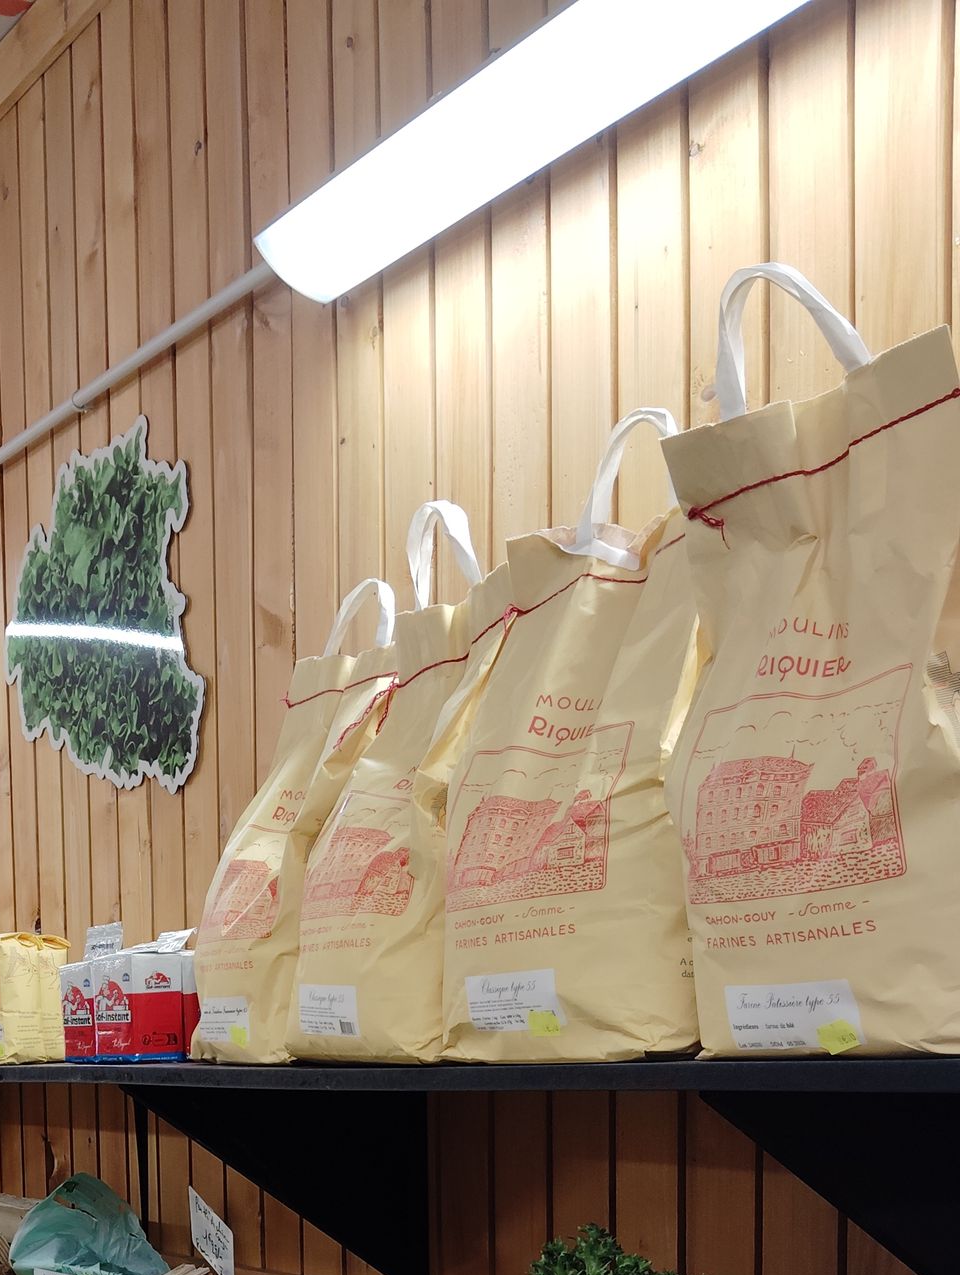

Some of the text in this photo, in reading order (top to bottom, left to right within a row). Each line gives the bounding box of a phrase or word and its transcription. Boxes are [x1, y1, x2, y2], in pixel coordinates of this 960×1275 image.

[536, 693, 603, 712] MOULI
[527, 715, 596, 747] RIQUIE
[455, 923, 576, 950] FARINES ARTISANALES
[706, 920, 877, 950] FARINES ARTISANALES
[805, 995, 824, 1013] type
